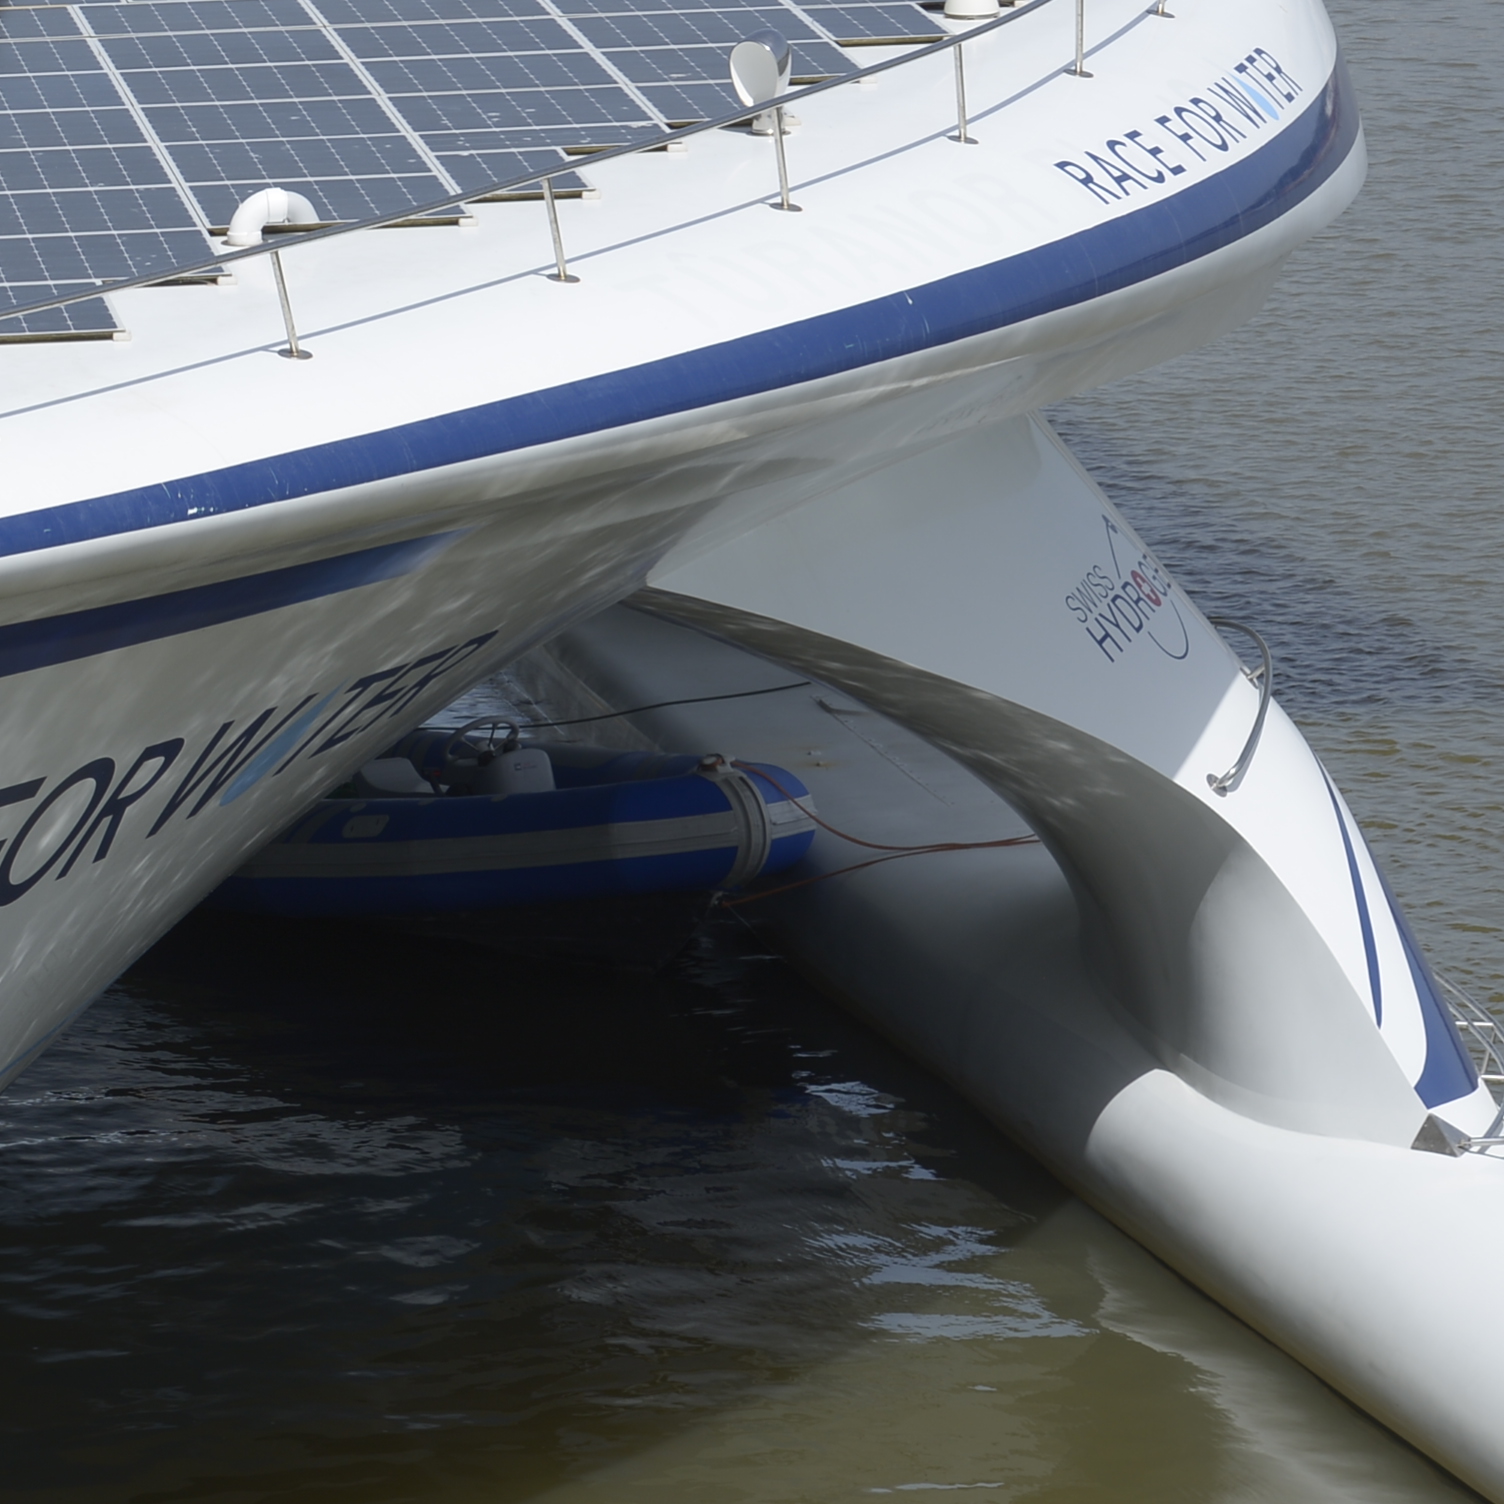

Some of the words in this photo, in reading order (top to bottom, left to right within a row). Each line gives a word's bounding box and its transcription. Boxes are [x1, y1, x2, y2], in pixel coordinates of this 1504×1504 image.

[1052, 129, 1187, 205] RACE
[1154, 97, 1247, 162] FOR
[1065, 564, 1115, 623] SWISS
